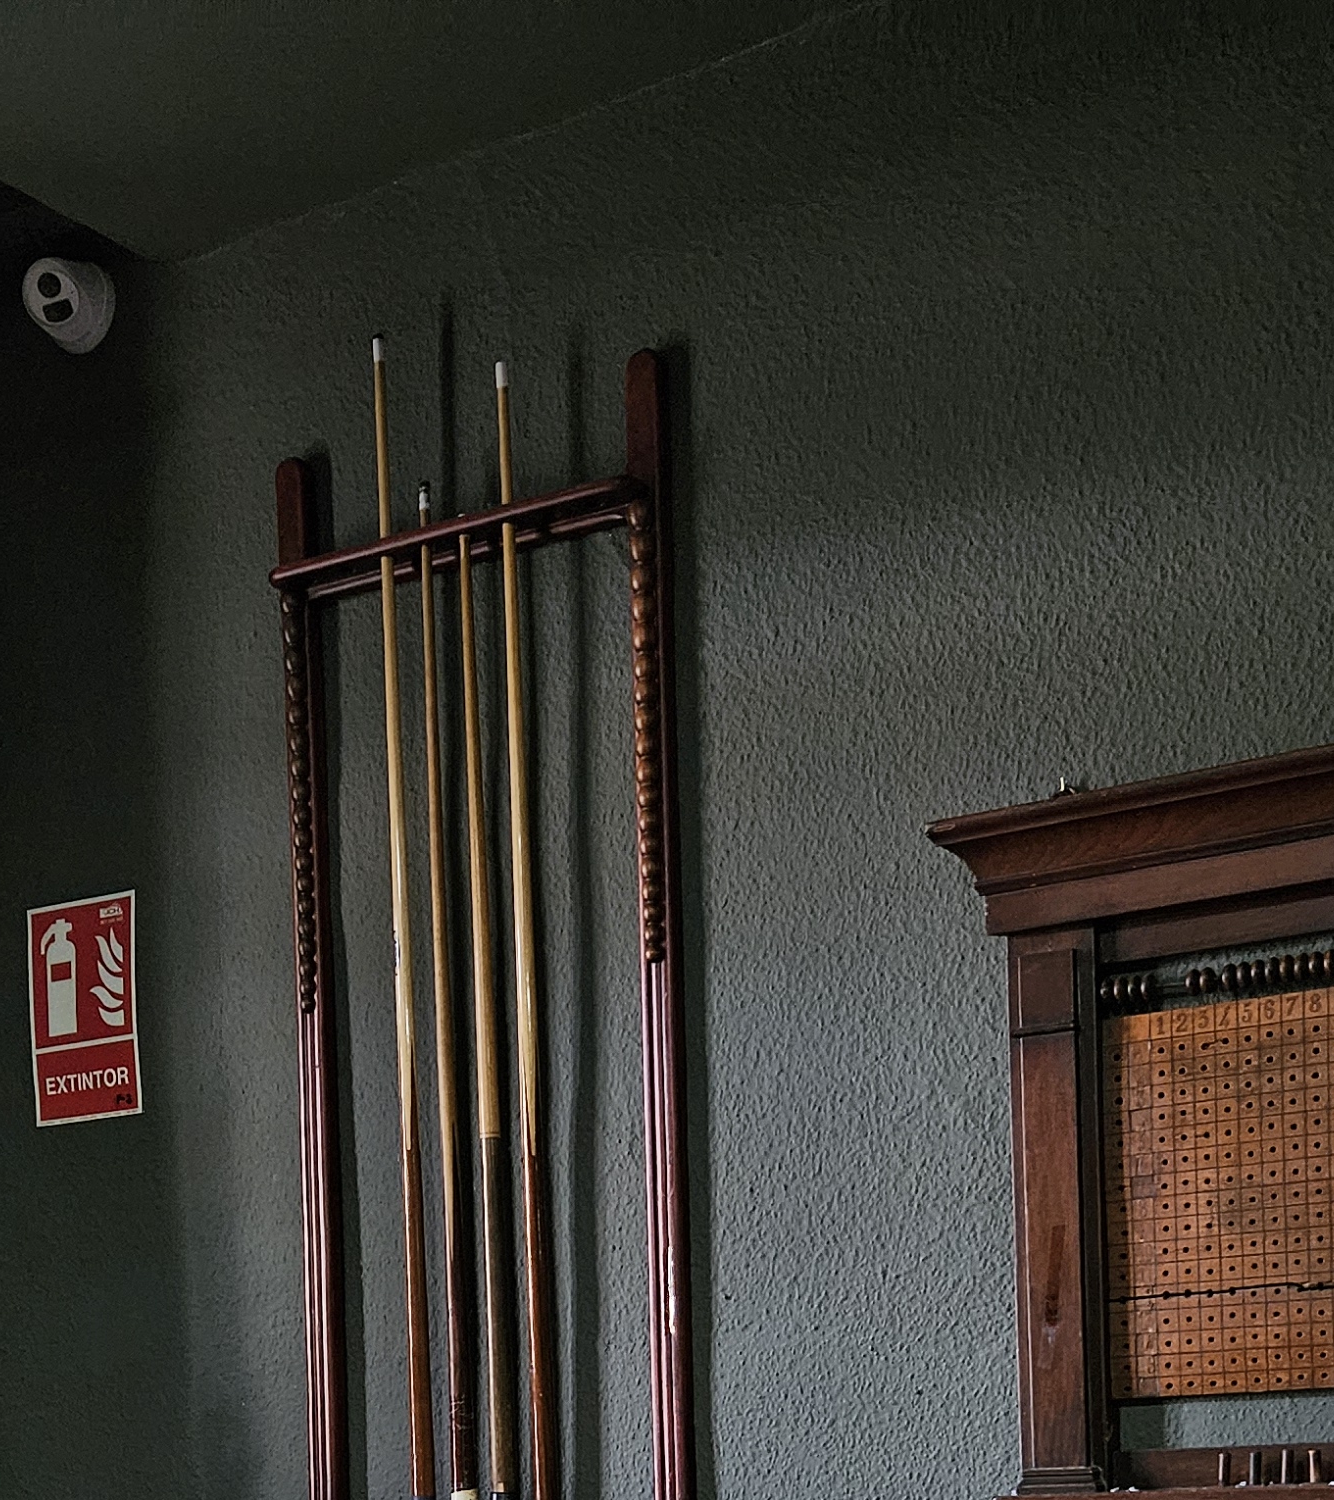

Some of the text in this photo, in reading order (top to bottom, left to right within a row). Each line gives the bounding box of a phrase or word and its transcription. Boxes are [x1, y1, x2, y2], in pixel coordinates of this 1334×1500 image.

[1156, 1014, 1165, 1035] 1
[1175, 1012, 1188, 1033] 2
[1198, 1010, 1210, 1029] 3
[1218, 1005, 1231, 1028] 4
[1242, 1001, 1253, 1023] 5
[1264, 999, 1275, 1020] 6
[1286, 995, 1299, 1017] 7
[1309, 993, 1322, 1013] 8
[45, 1066, 129, 1096] EXTINTOR
